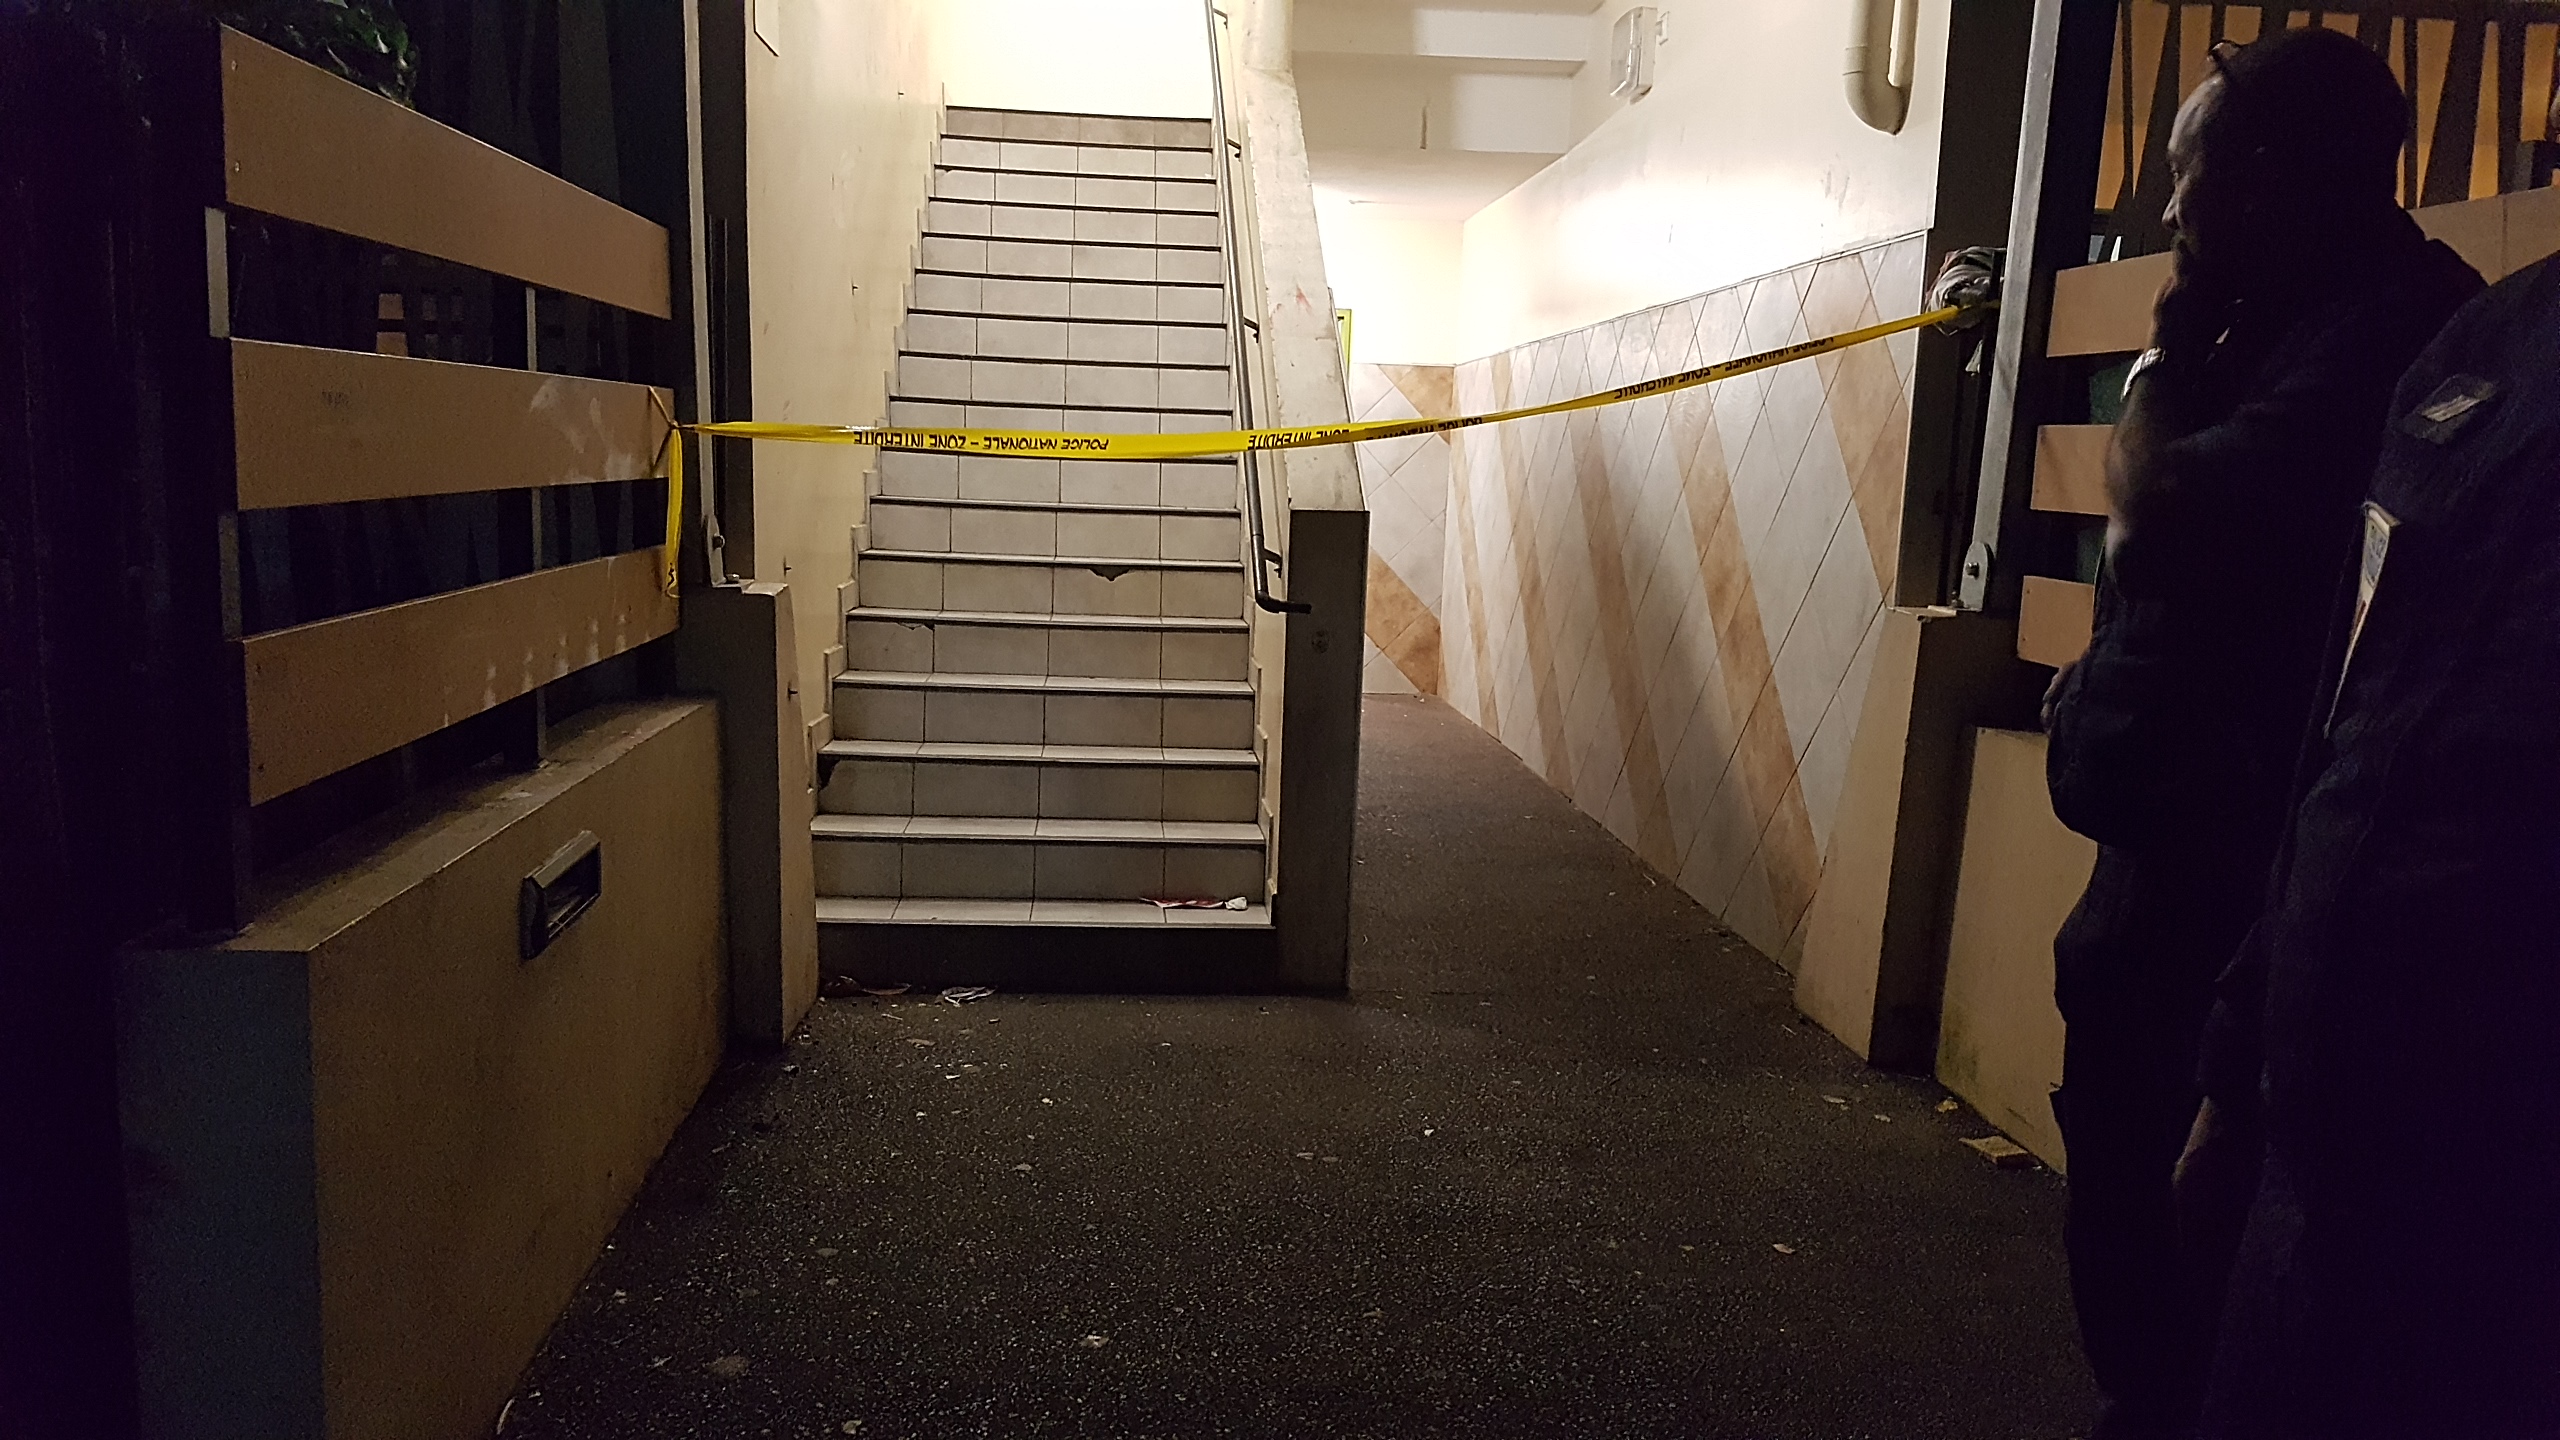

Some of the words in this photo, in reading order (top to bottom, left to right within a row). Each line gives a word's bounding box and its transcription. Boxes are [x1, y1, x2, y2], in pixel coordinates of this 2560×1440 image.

[853, 431, 924, 448] INTERDITE
[928, 434, 967, 449] ZONE
[983, 436, 1058, 450] NATIONALE
[1061, 438, 1109, 450] POLICE
[1247, 430, 1312, 450] INTERDITE
